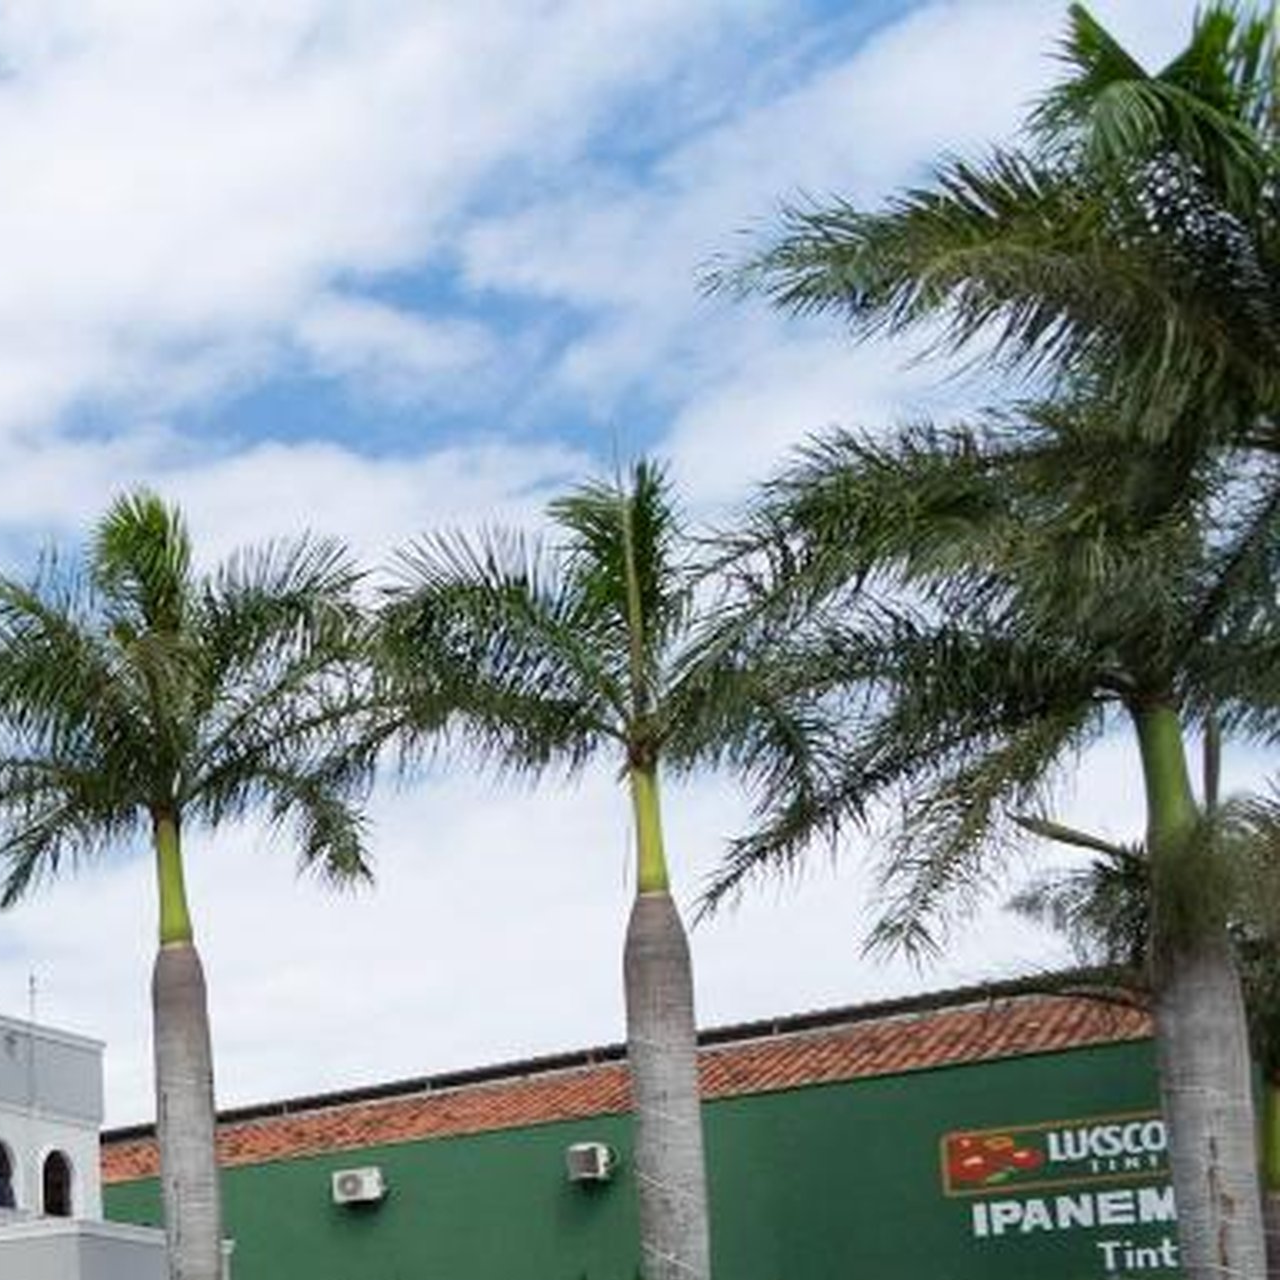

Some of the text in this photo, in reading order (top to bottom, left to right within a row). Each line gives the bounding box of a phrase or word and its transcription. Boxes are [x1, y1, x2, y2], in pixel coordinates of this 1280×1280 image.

[1046, 1119, 1168, 1162] LUKSCO
[971, 1185, 1179, 1237] IPANEM
[1095, 1238, 1180, 1271] Tint
